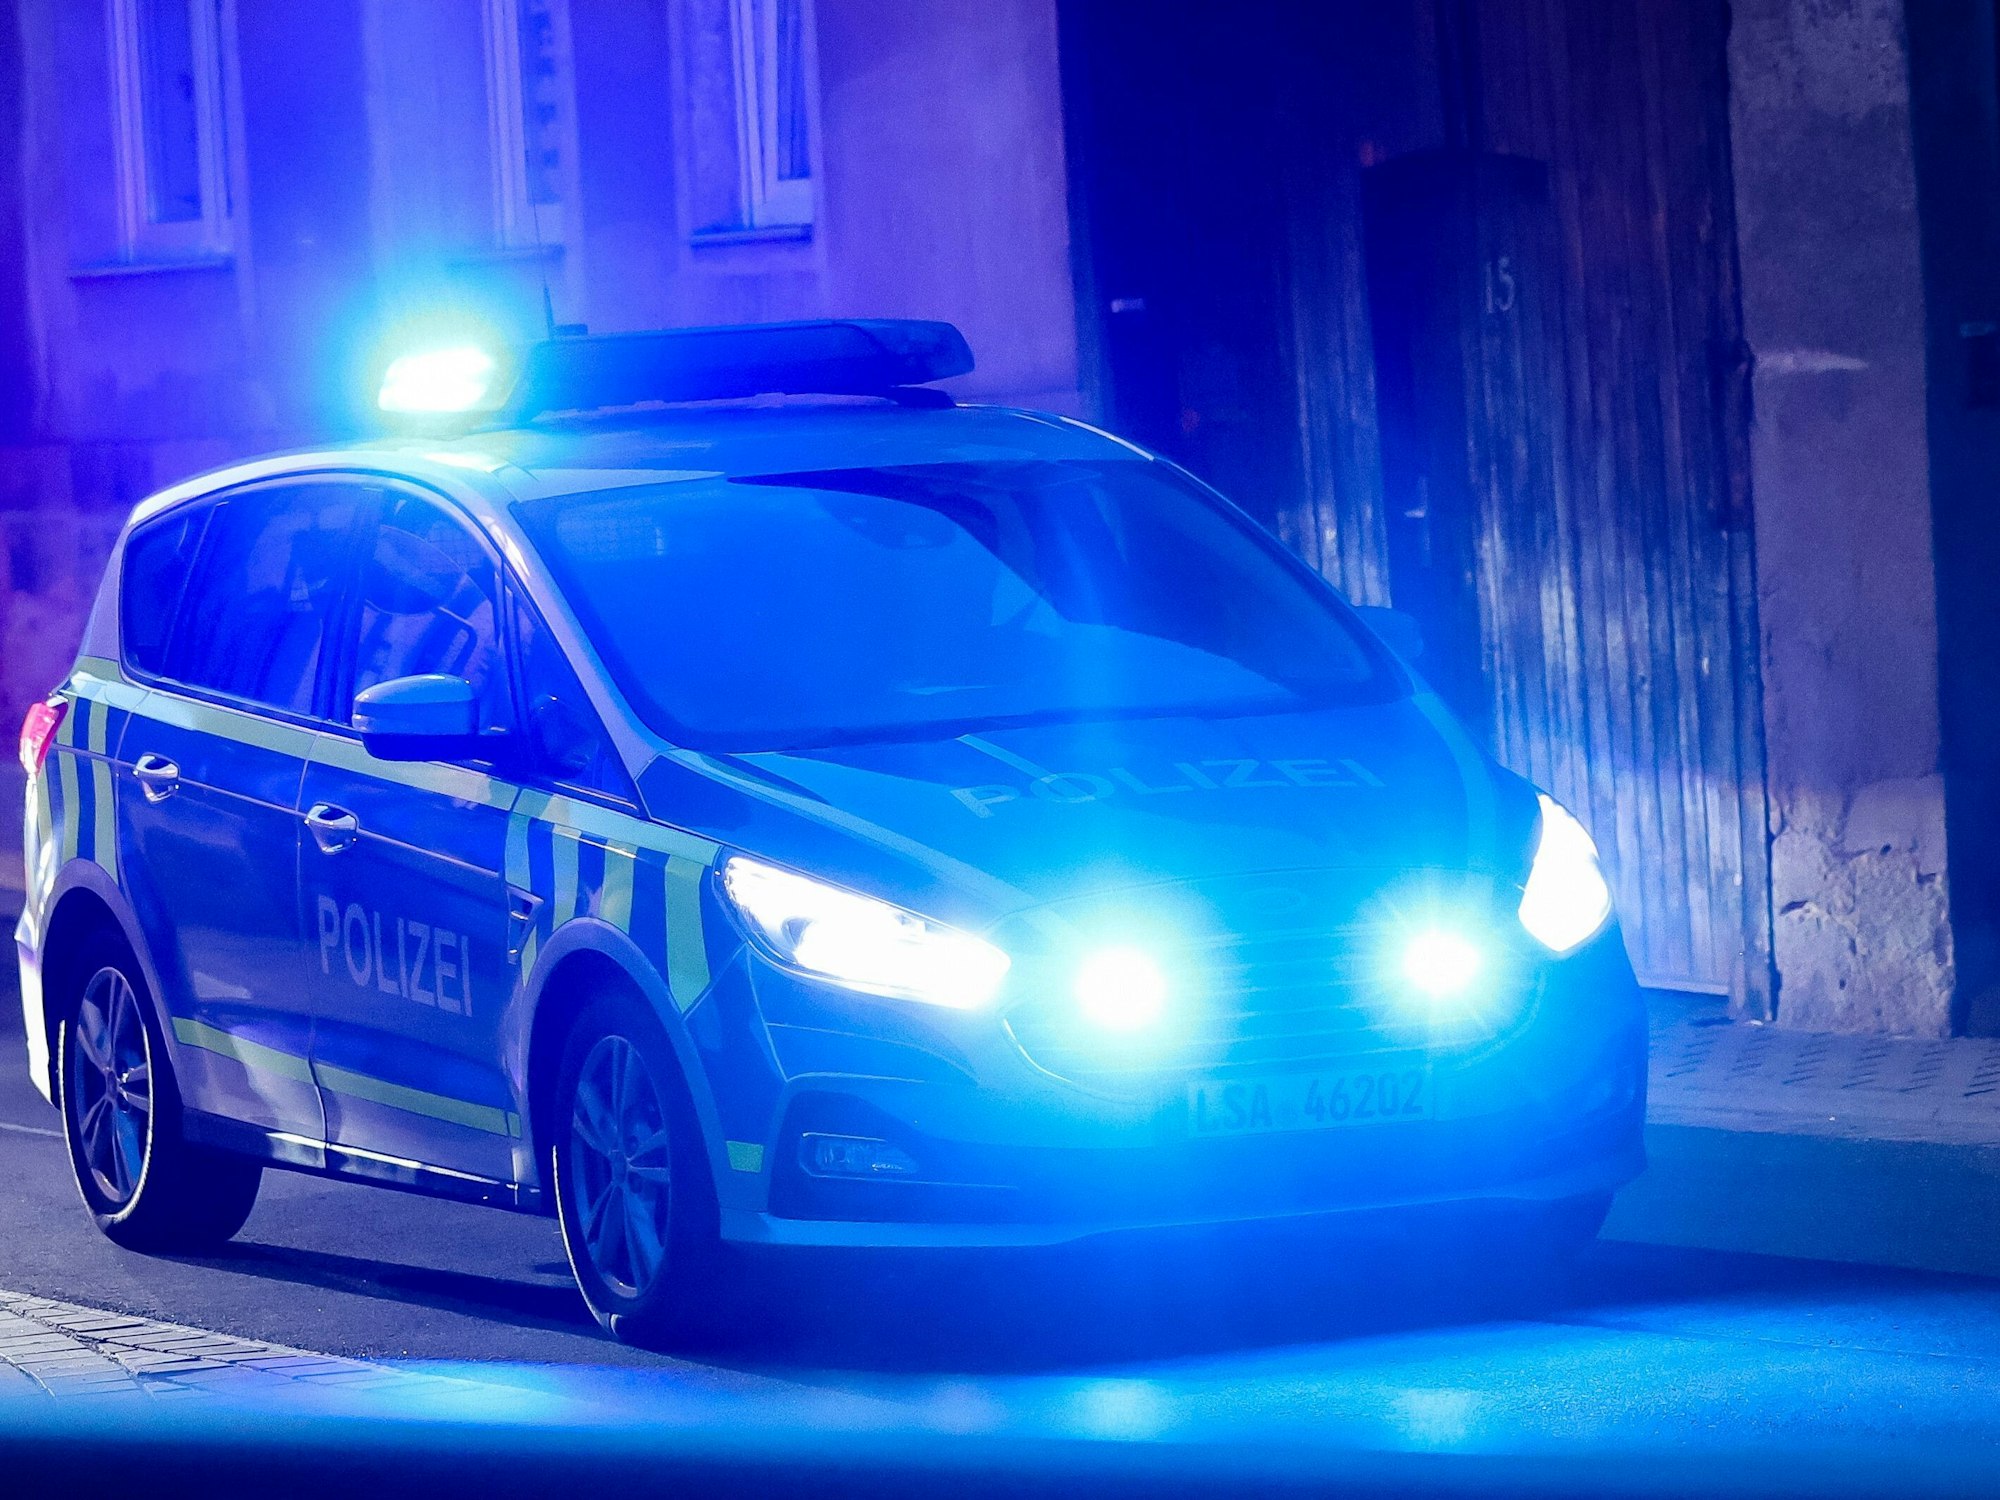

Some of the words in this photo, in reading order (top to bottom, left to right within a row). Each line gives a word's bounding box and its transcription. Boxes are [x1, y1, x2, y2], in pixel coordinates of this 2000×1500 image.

[1485, 256, 1515, 313] 15
[949, 757, 1388, 819] POLIZEI
[317, 893, 473, 1018] POLIZEI
[1303, 1069, 1424, 1123] 46202
